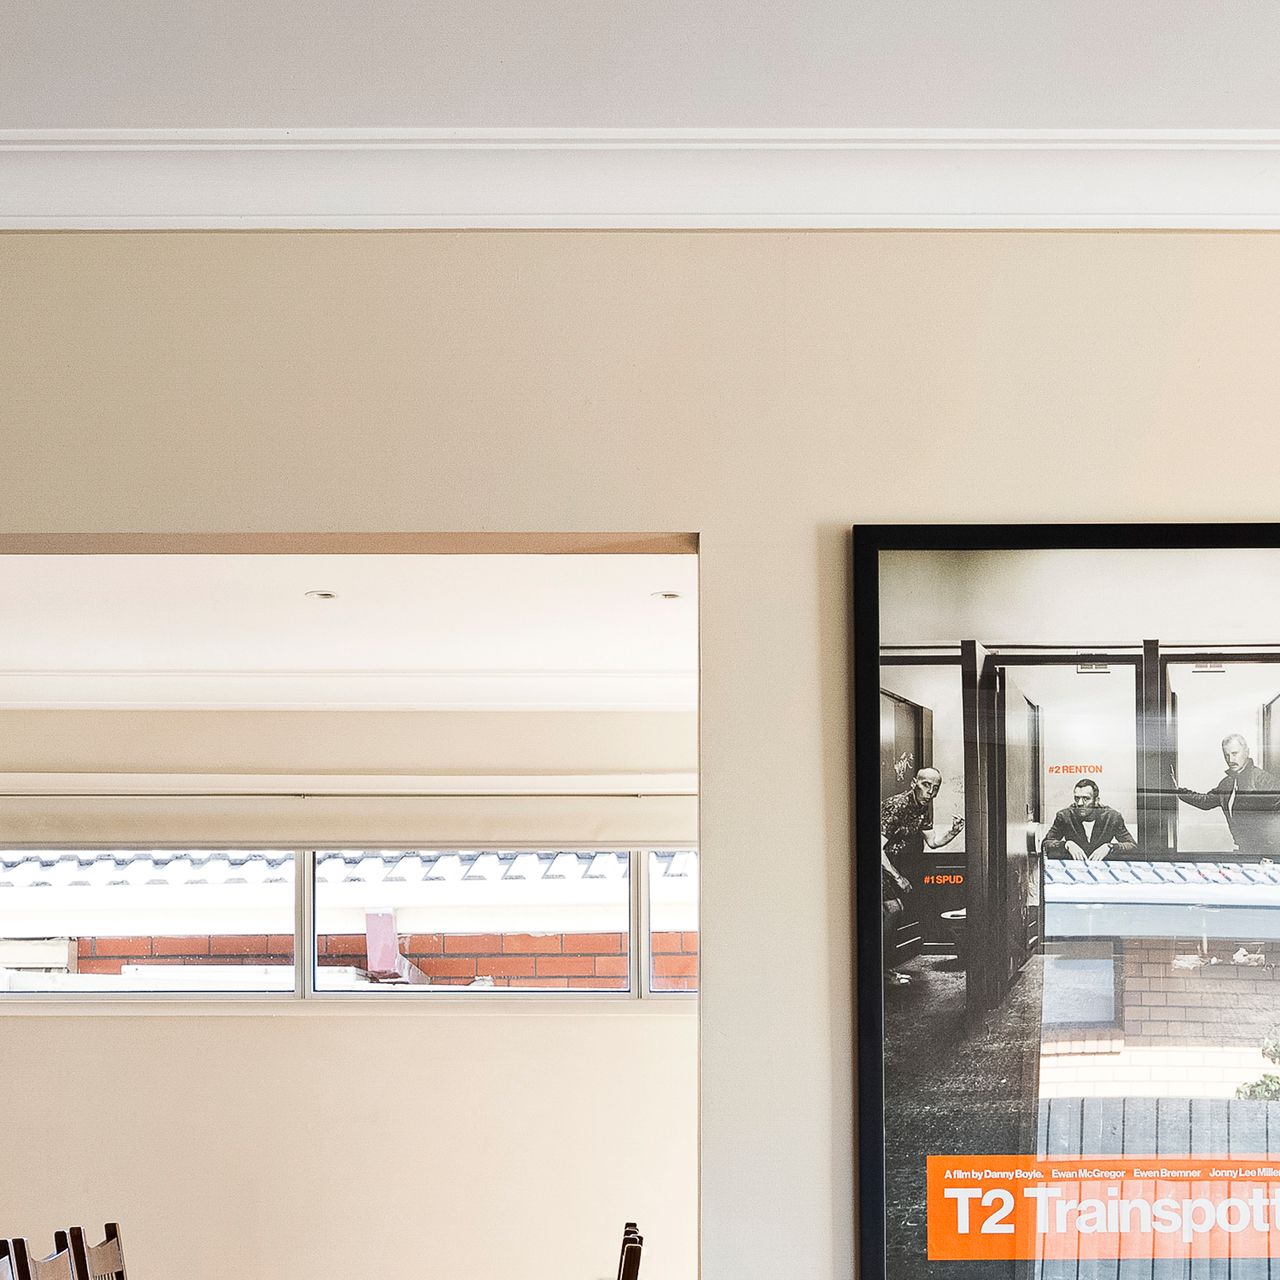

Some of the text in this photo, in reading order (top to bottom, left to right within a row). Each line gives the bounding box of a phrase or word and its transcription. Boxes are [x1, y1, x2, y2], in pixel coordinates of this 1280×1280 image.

[1062, 765, 1103, 774] RENTON
[936, 875, 964, 884] SPUD
[945, 1170, 952, 1179] A
[953, 1170, 970, 1179] film
[971, 1170, 983, 1181] by
[984, 1170, 1014, 1181] Danny
[1052, 1169, 1077, 1178] Ewan
[1078, 1169, 1126, 1181] McGregor
[1134, 1169, 1159, 1178] Ewen
[1160, 1168, 1201, 1178] Bremner
[1209, 1168, 1238, 1179] Jonny
[1239, 1168, 1257, 1177] Lee
[943, 1187, 1015, 1234] T2
